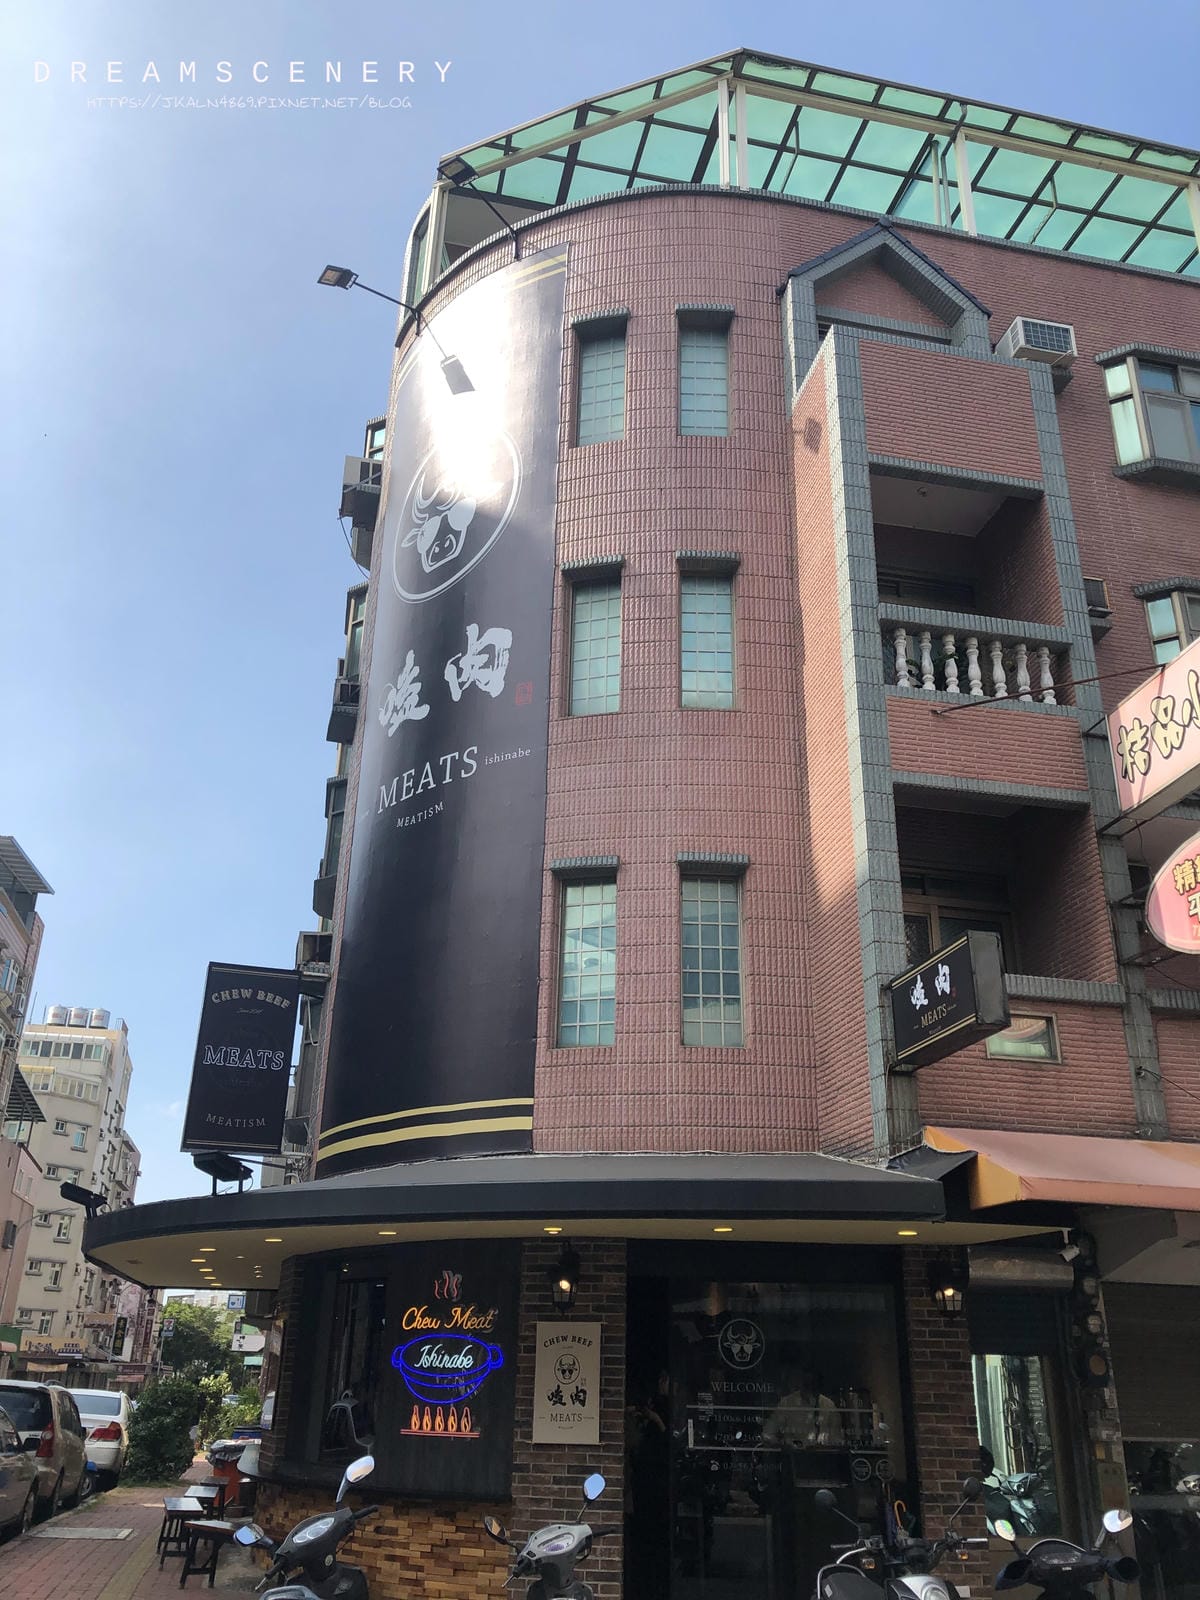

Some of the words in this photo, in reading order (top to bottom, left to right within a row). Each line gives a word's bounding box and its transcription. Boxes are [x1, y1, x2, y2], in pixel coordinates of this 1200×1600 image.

[377, 746, 479, 814] MEATS
[484, 748, 532, 766] ishinabe
[396, 801, 445, 829] MEATISM
[211, 988, 253, 1004] CHEW
[256, 989, 292, 1010] BEEF
[921, 1003, 947, 1028] MEATS
[203, 1045, 285, 1071] MEATS
[206, 1113, 266, 1128] MEATISM
[443, 1304, 499, 1331] Meat
[543, 1334, 569, 1349] CHEW
[570, 1335, 594, 1348] BEEF
[414, 1344, 474, 1369] Ishinabe
[711, 1381, 775, 1393] WELCOME
[550, 1413, 583, 1423] MEATS
